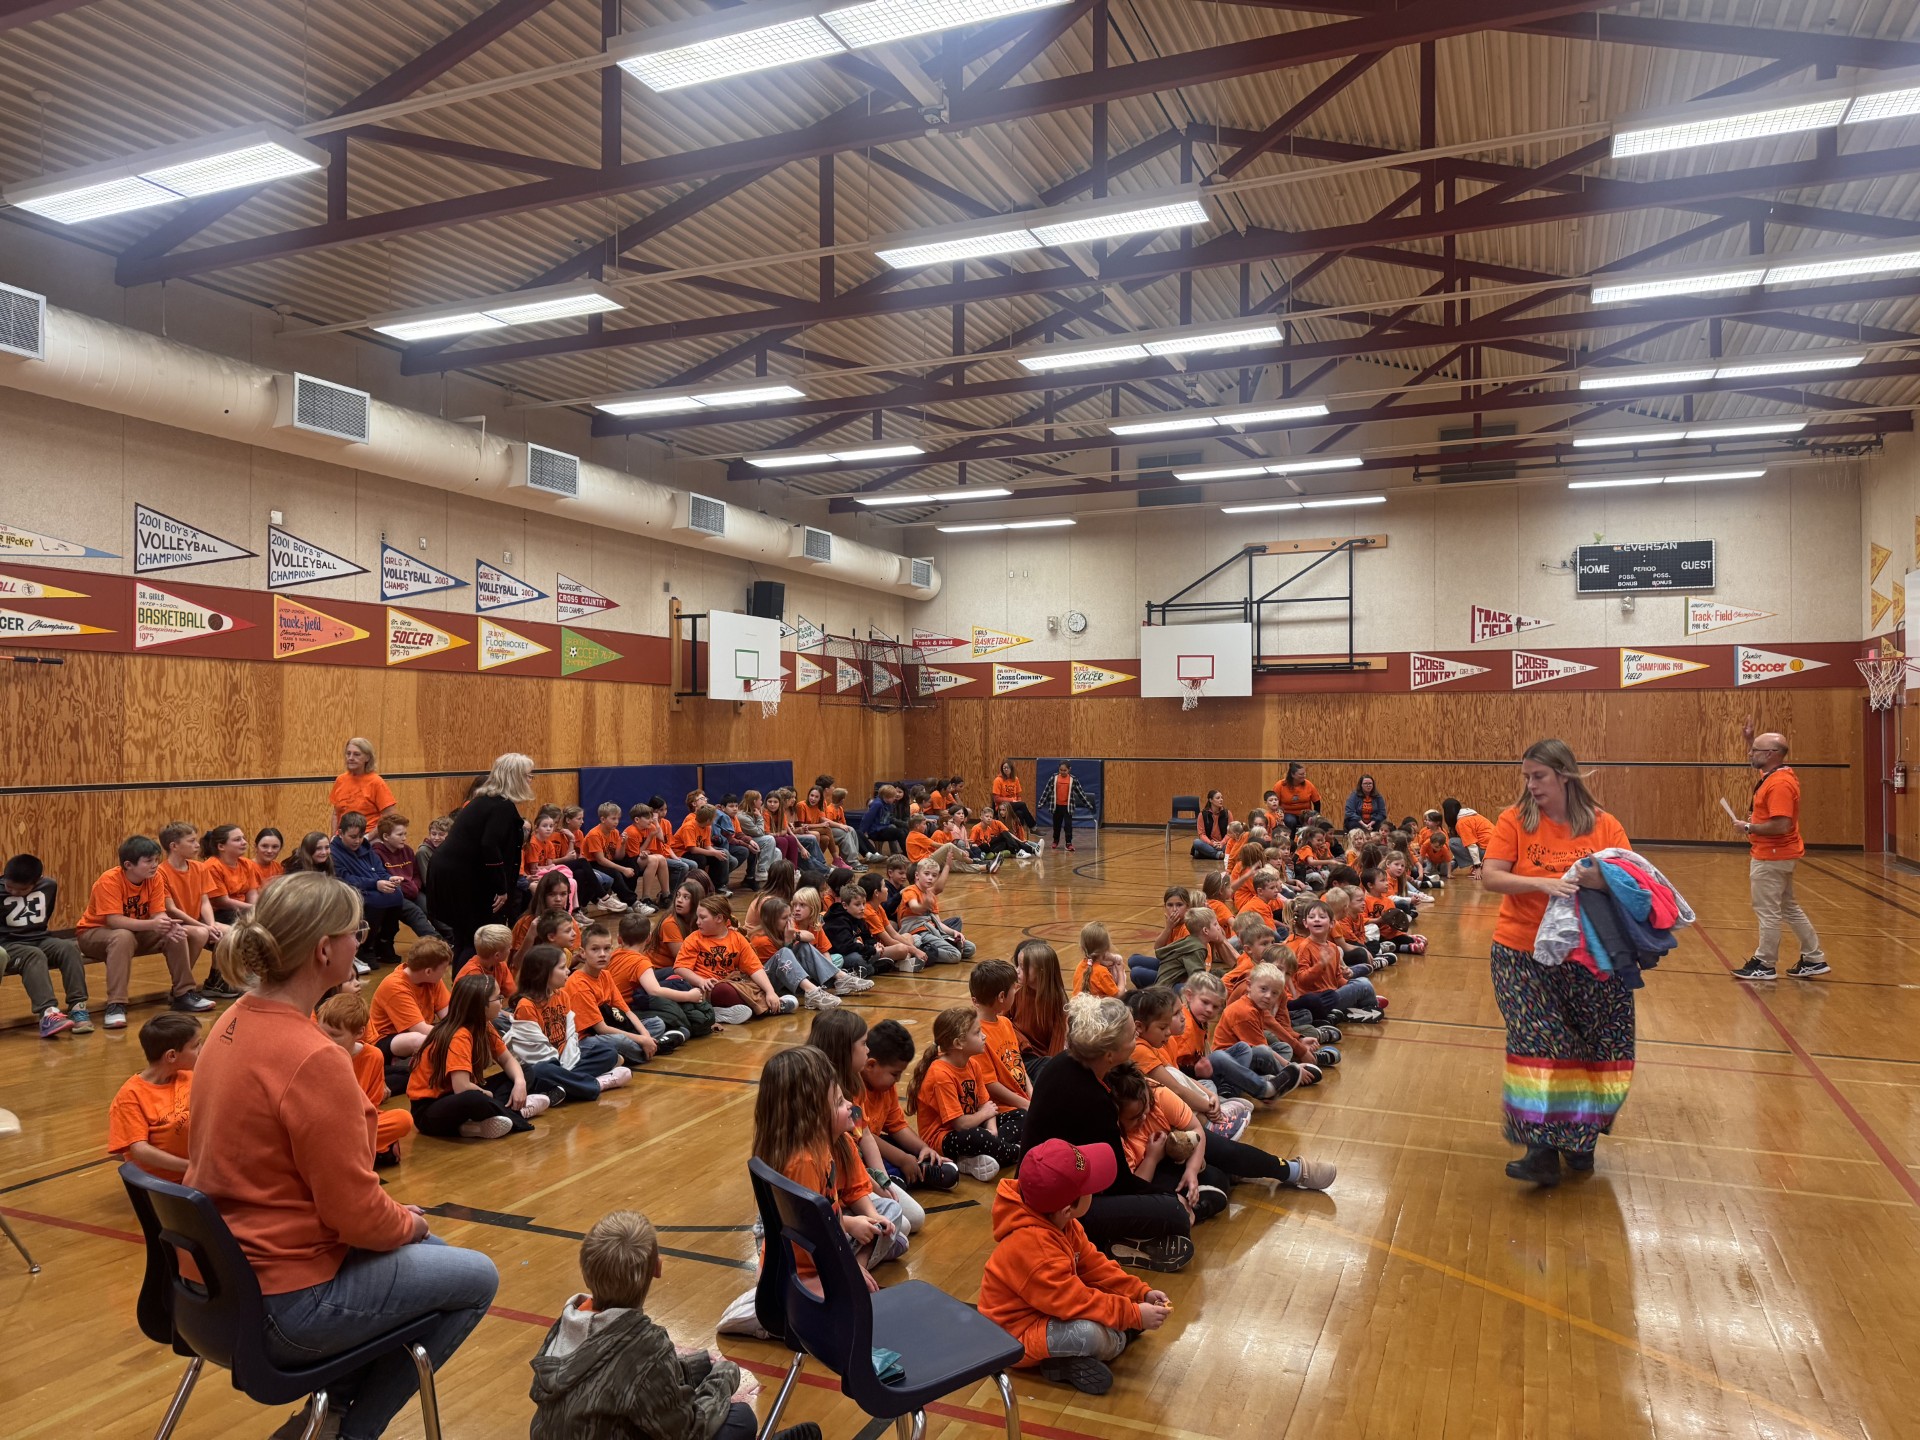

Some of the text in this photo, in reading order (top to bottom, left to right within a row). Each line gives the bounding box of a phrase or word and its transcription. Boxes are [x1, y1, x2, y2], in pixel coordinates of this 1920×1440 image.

[139, 512, 161, 529] 2001
[164, 521, 189, 537] BOY'S
[6, 535, 33, 548] HOCKEY
[138, 528, 218, 553] VOLLEYBALL
[271, 533, 290, 549] 2001
[1623, 542, 1678, 552] EVERSAN
[138, 552, 193, 566] CHAMPIONS
[271, 548, 337, 570] VOLLEYBALL
[384, 556, 403, 567] GIRLS
[1681, 560, 1712, 570] GUEST
[270, 570, 316, 582] CHAMPIONS
[383, 566, 432, 584] VOLLEYBALL
[1580, 564, 1610, 574] HOME
[384, 580, 409, 592] CHAMPS
[478, 581, 519, 597] VOLLEYBALL
[478, 594, 501, 604] CHAMPS
[558, 593, 607, 607] CROSS COUNTRY
[138, 607, 206, 629] BASKETBALL
[1477, 607, 1513, 623] TRACK
[1692, 610, 1713, 622] Track
[1715, 610, 1733, 622] Field
[139, 632, 154, 641] 1975
[391, 630, 434, 647] SOCCER
[1481, 624, 1513, 639] FIELD
[280, 642, 295, 652] 1975
[974, 637, 1014, 645] BASKETBALL
[1413, 656, 1445, 670] CROSS
[1516, 653, 1549, 669] CROSS
[1635, 662, 1671, 671] CHAMPIONS
[1742, 660, 1787, 672] Soccer
[1413, 671, 1457, 687] COUNTRY
[1516, 670, 1561, 685] COUNTRY
[1625, 672, 1643, 680] FIELD
[3, 890, 46, 927] 23
